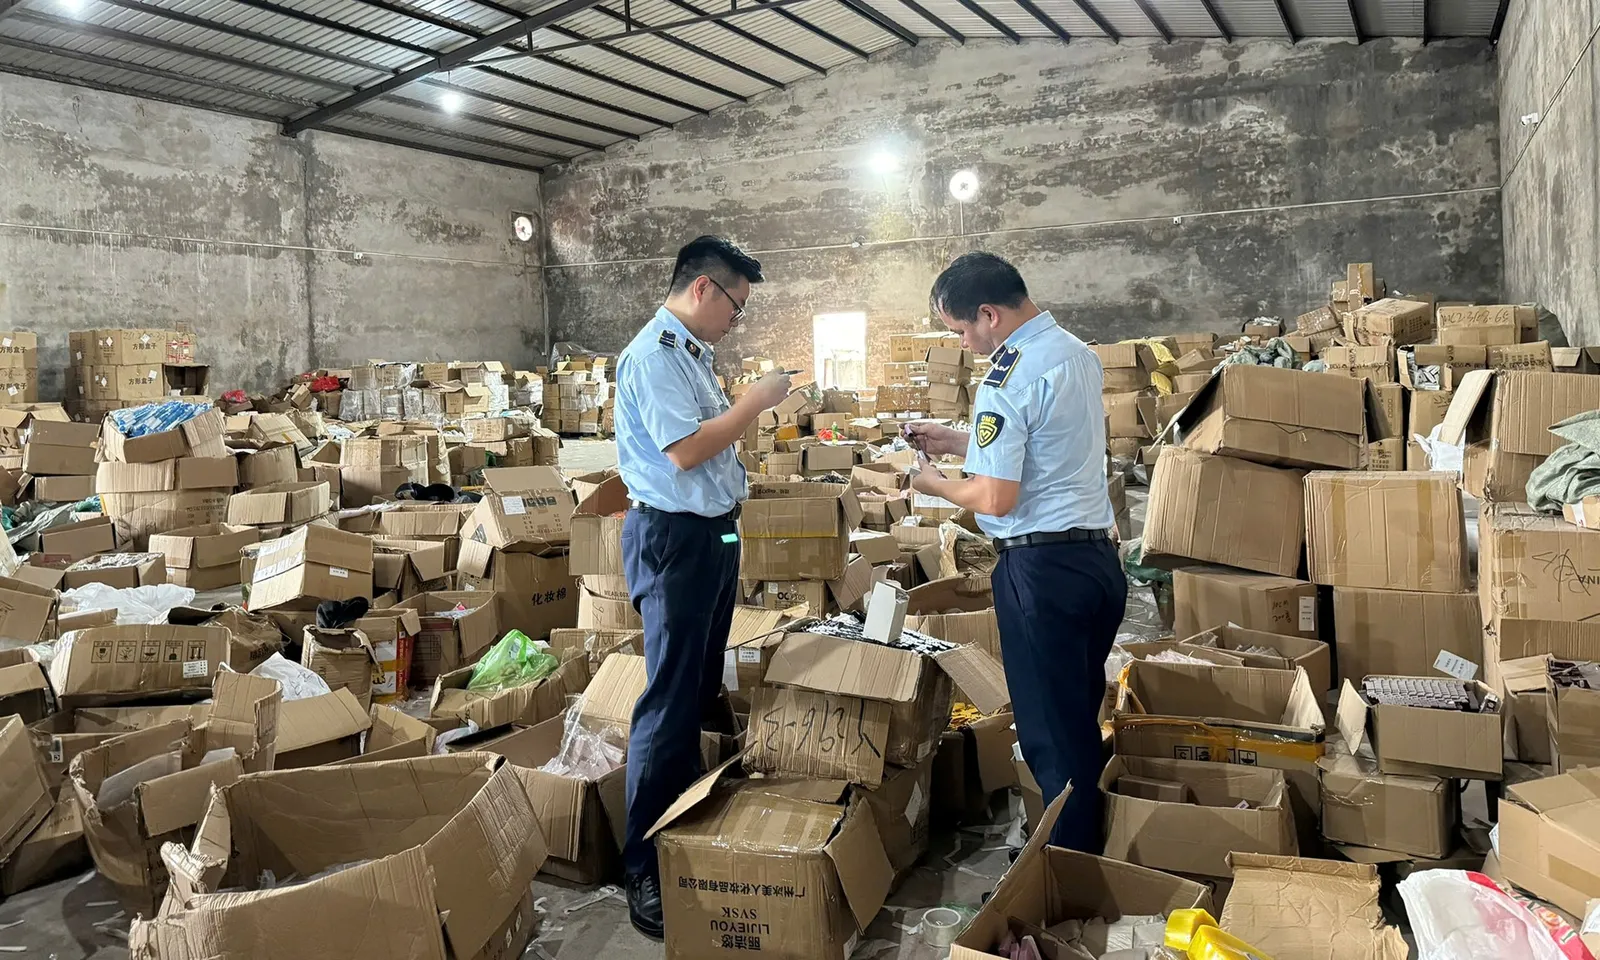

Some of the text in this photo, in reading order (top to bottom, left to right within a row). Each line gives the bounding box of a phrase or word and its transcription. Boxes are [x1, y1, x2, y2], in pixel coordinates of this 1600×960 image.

[678, 876, 806, 898] 广州冰美人化妆品有限公司
[721, 906, 758, 919] SVSK
[710, 919, 770, 934] LIJIEYOU
